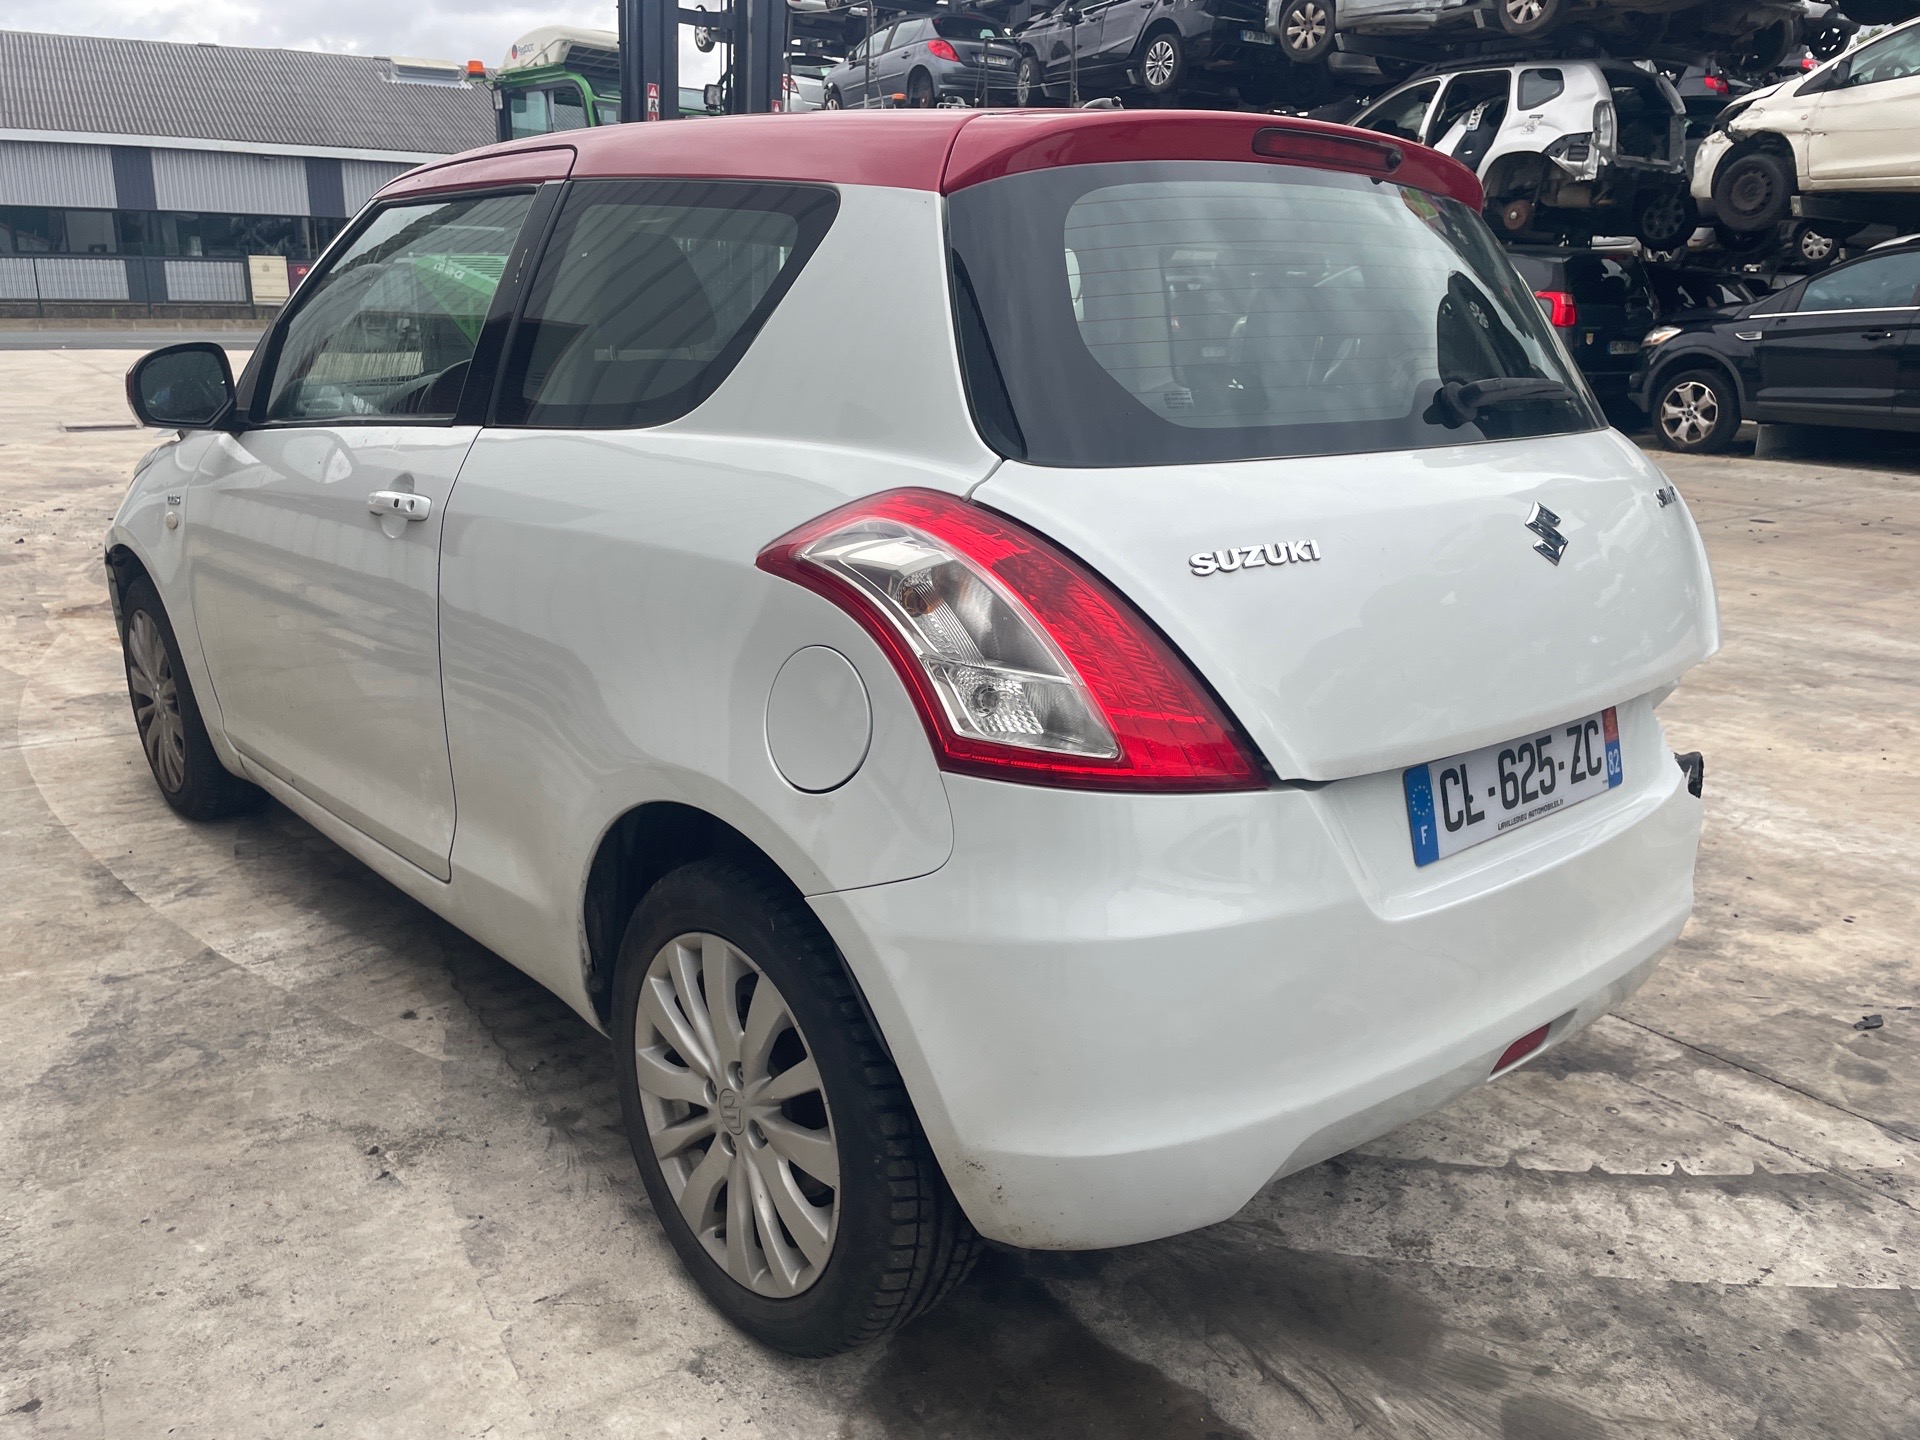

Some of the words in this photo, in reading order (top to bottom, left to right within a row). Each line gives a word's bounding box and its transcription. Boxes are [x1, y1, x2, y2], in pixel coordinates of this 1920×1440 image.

[1189, 539, 1321, 577] SUZUKI
[1439, 719, 1602, 833] CL-625-ZC
[1608, 748, 1621, 776] 82
[1420, 825, 1429, 845] F
